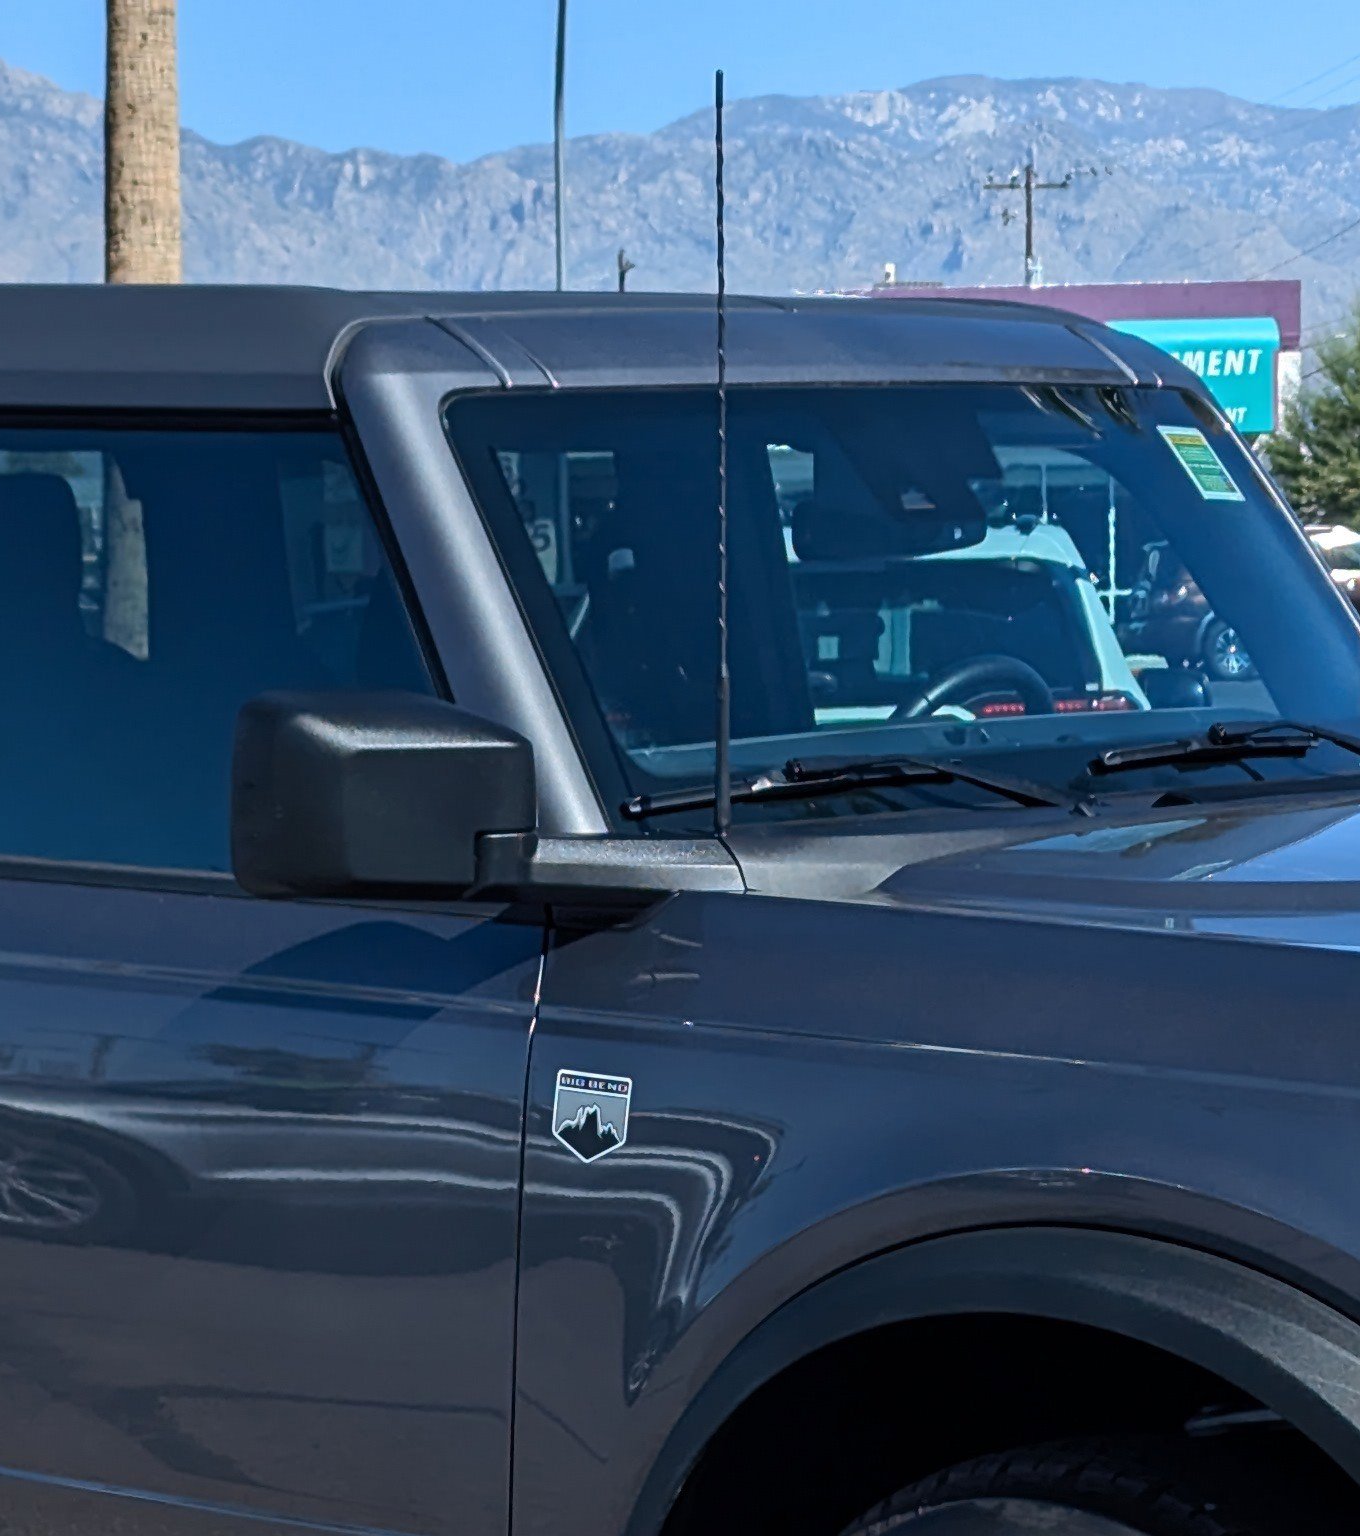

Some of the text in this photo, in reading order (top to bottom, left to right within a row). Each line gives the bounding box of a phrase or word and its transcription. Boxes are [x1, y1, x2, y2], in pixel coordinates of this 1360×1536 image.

[1170, 348, 1264, 377] MENT
[561, 1076, 627, 1092] BIG BEND
